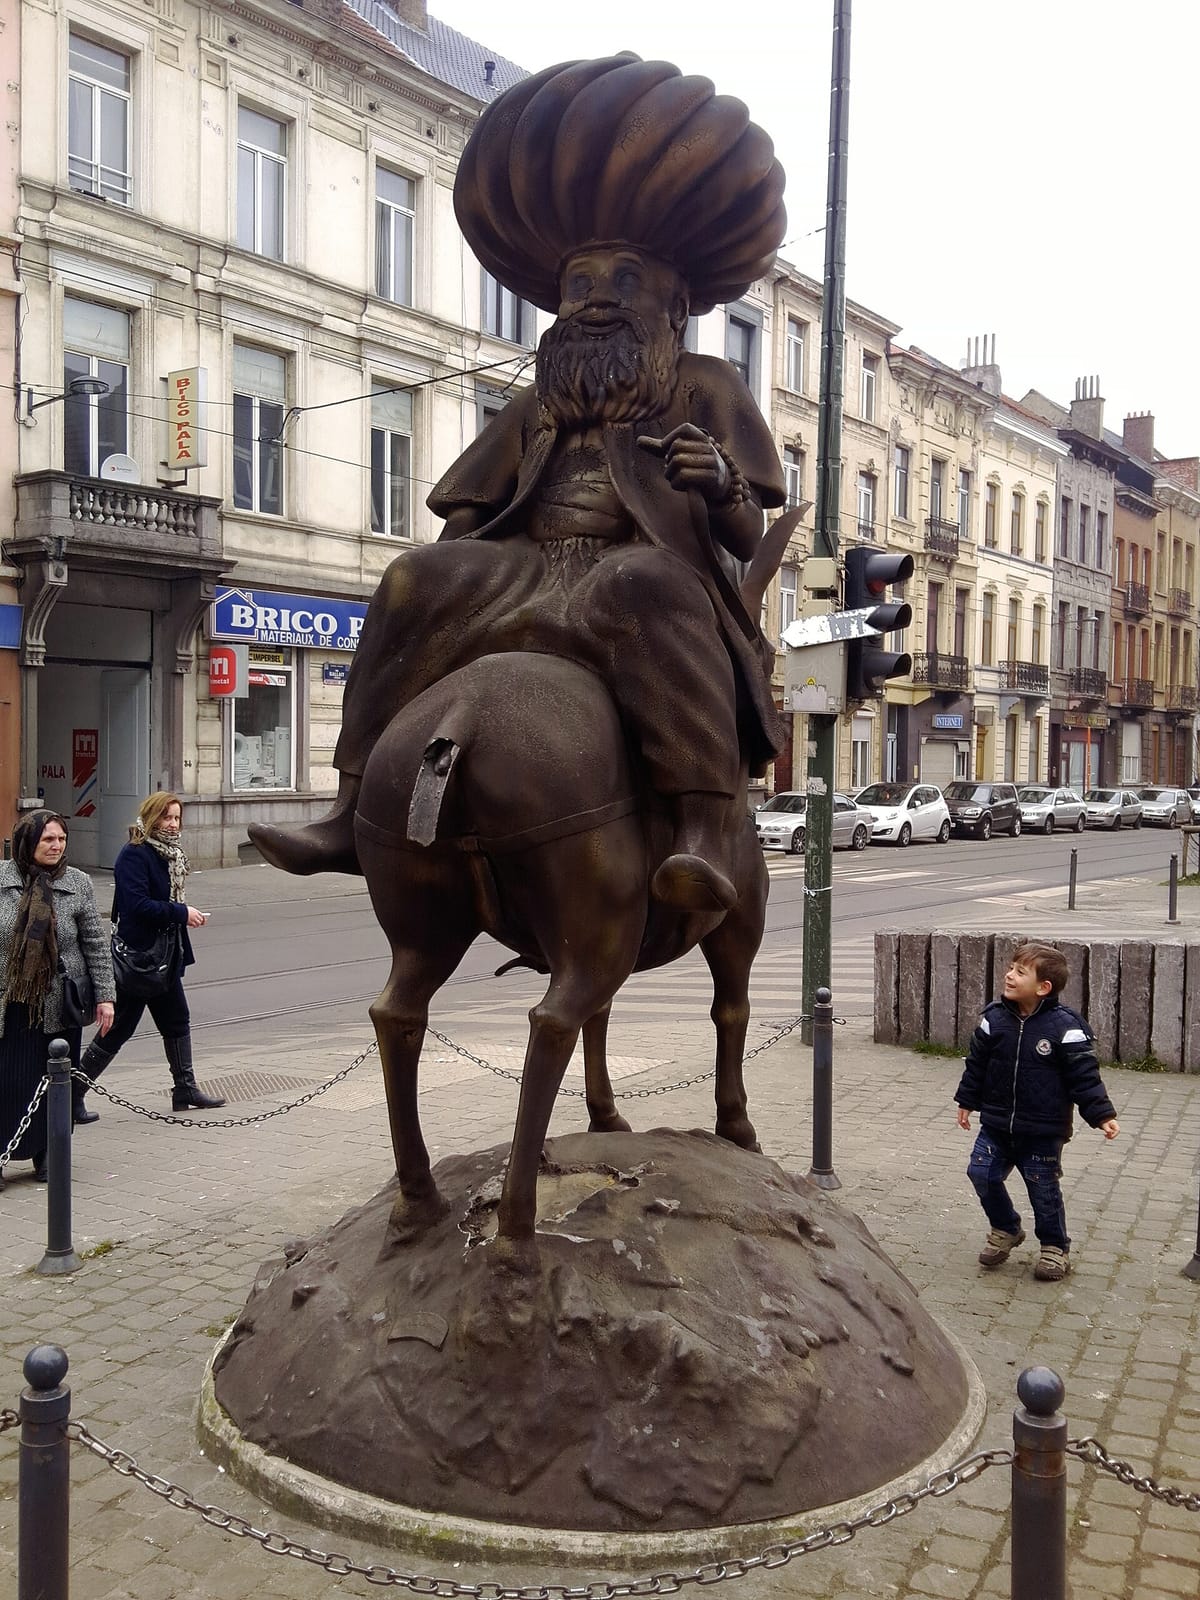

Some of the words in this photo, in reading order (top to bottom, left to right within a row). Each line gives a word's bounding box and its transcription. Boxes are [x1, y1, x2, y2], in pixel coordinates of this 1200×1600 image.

[176, 421, 191, 460] PALA
[231, 604, 338, 636] BRICO
[260, 630, 314, 646] MATERIAUX
[319, 634, 333, 647] DE
[936, 717, 961, 727] INTERNET
[42, 765, 65, 779] PALA
